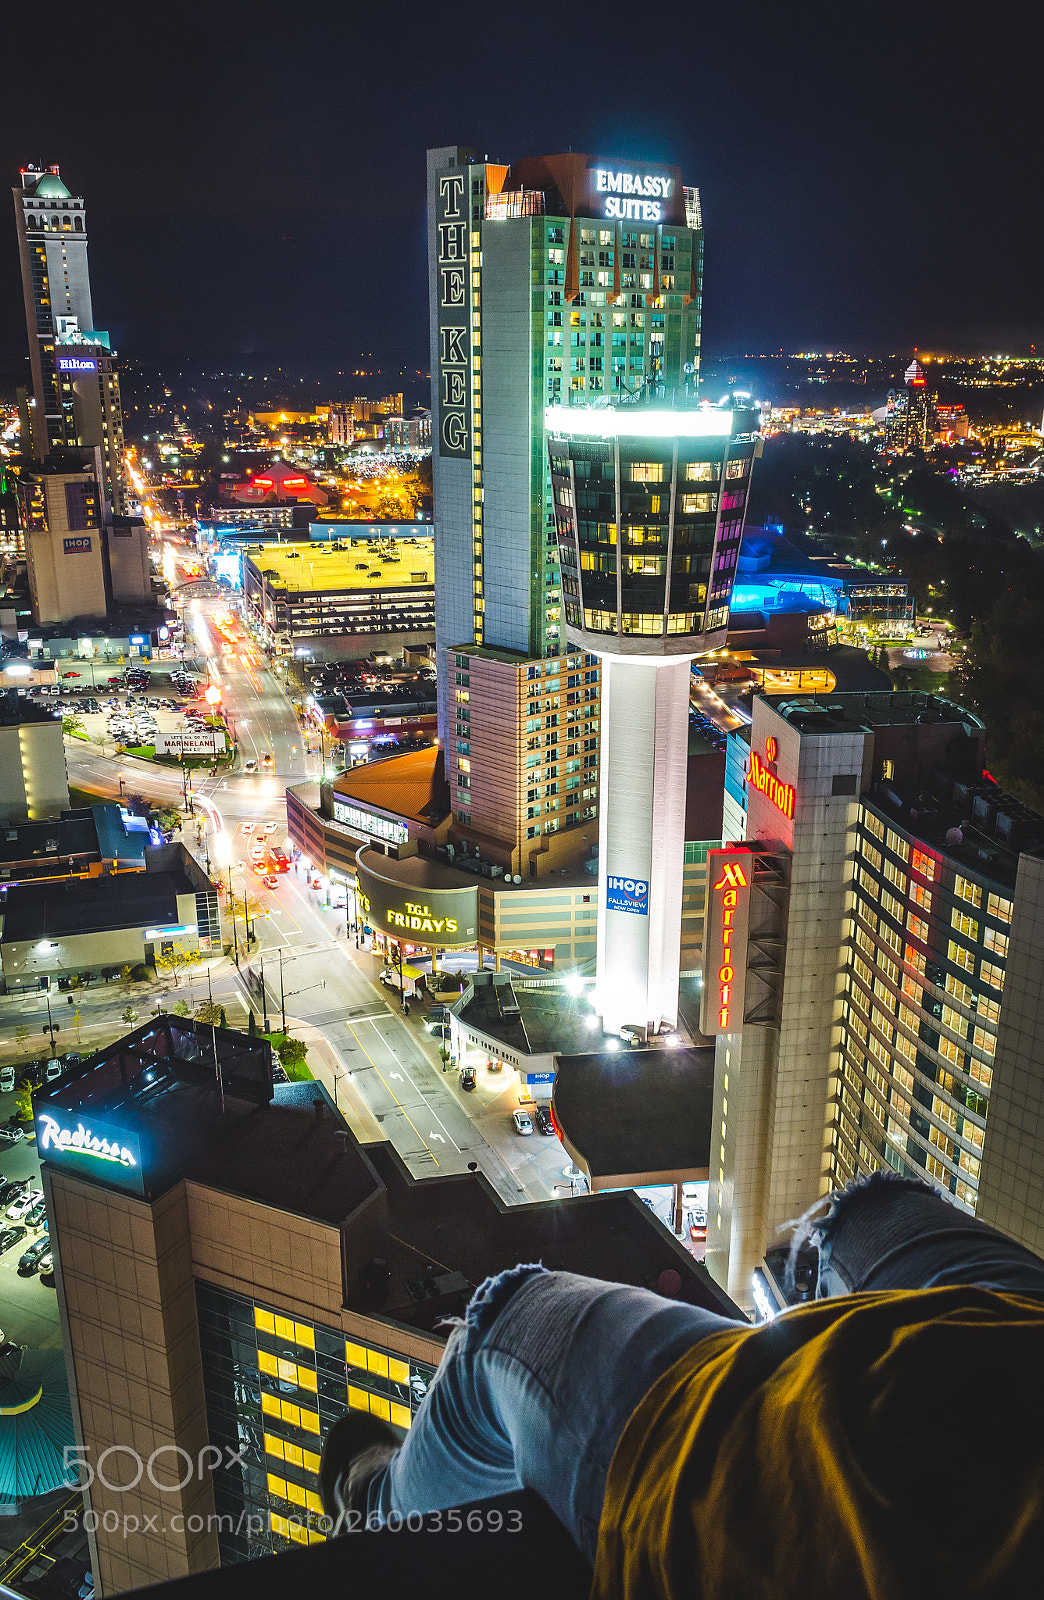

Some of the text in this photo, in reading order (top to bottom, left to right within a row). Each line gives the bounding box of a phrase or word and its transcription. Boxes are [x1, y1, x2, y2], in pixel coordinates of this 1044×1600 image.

[597, 170, 671, 198] EMBASSY
[605, 197, 661, 220] SUITES
[438, 175, 468, 450] THE KEG
[60, 359, 95, 369] Hilton
[65, 539, 90, 548] IHOP
[746, 751, 796, 820] Marriott
[608, 877, 647, 897] IHOP
[405, 902, 432, 917] T.G.I.
[608, 898, 647, 909] FALLSVIEW
[387, 909, 458, 933] FRIDAY'S
[714, 862, 748, 1029] Marriott
[480, 1040, 499, 1055] TOWER
[501, 1051, 520, 1066] HOTEL
[38, 1114, 137, 1165] Radisson
